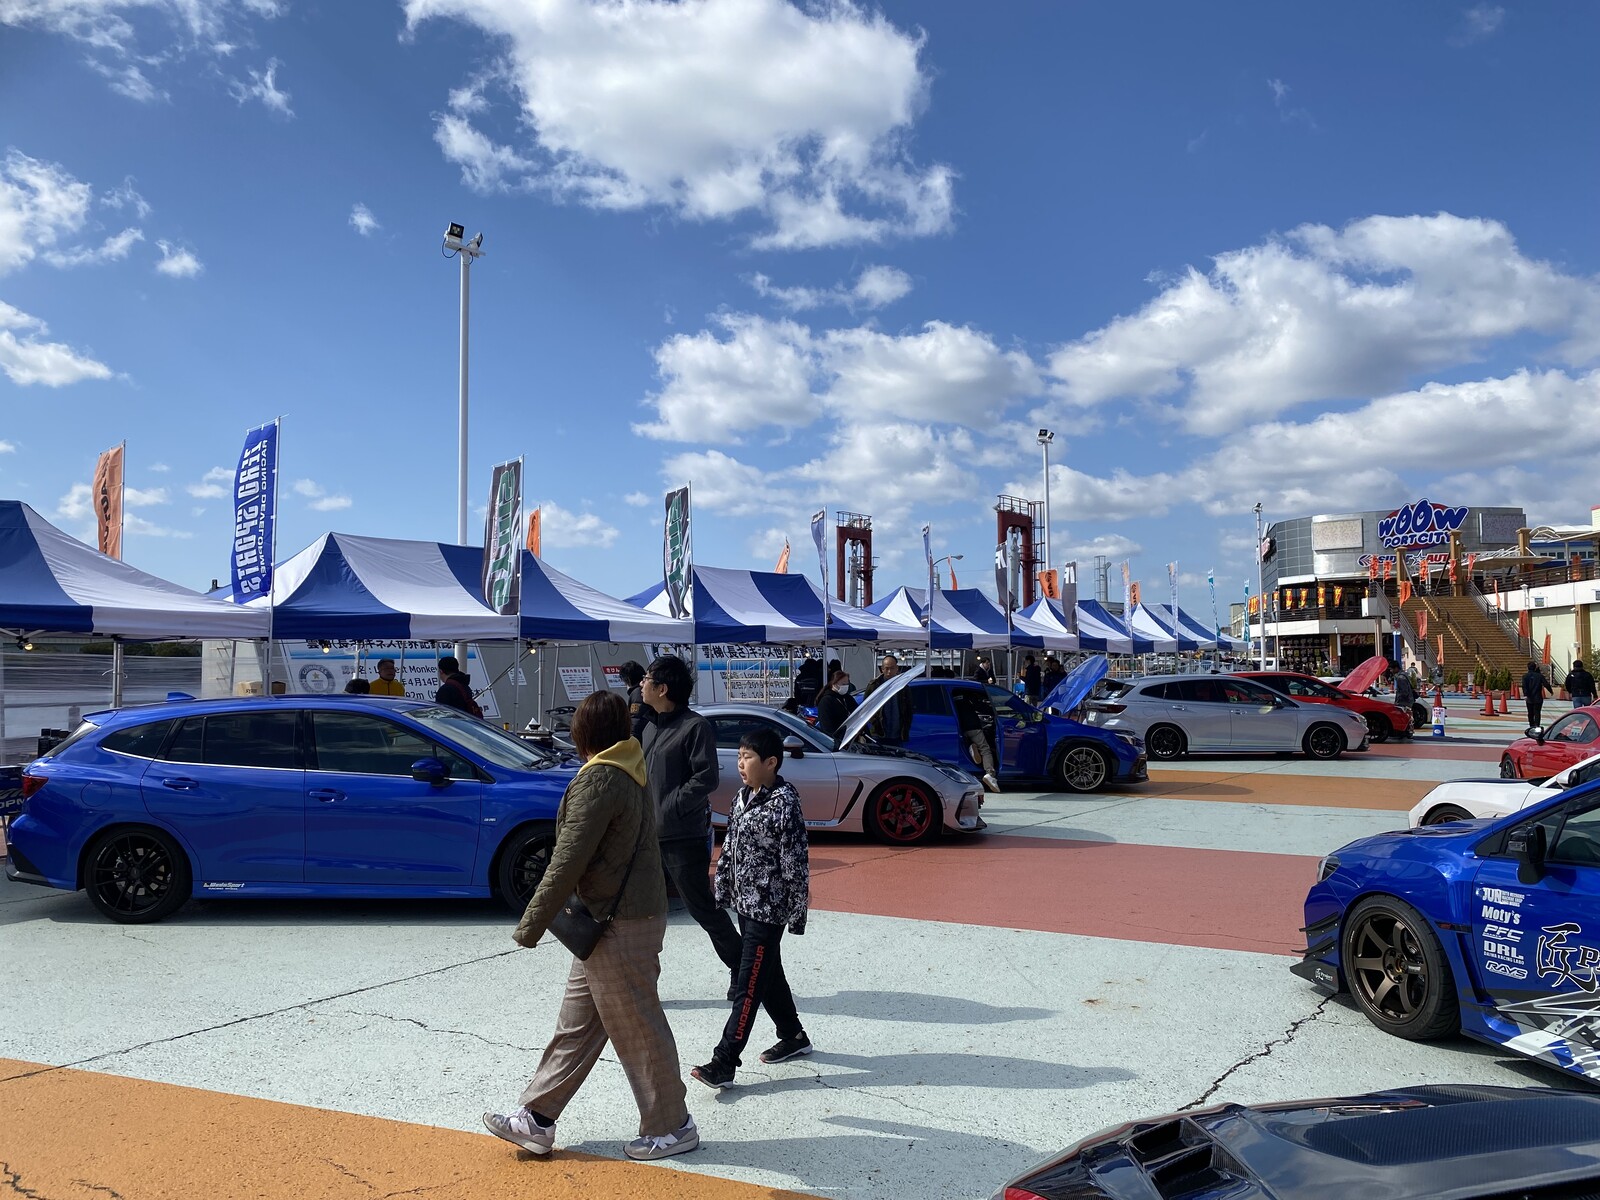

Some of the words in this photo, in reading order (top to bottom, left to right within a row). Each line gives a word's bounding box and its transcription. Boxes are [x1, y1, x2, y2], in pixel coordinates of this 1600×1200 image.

[1384, 534, 1416, 548] PORT
[1416, 531, 1451, 544] CITY
[1482, 905, 1521, 925] Moty's
[1484, 924, 1524, 942] PFC
[1484, 940, 1524, 961] DRL
[1486, 961, 1528, 979] RAYS
[735, 998, 753, 1040] UNDER
[748, 945, 764, 997] ARMOUR
